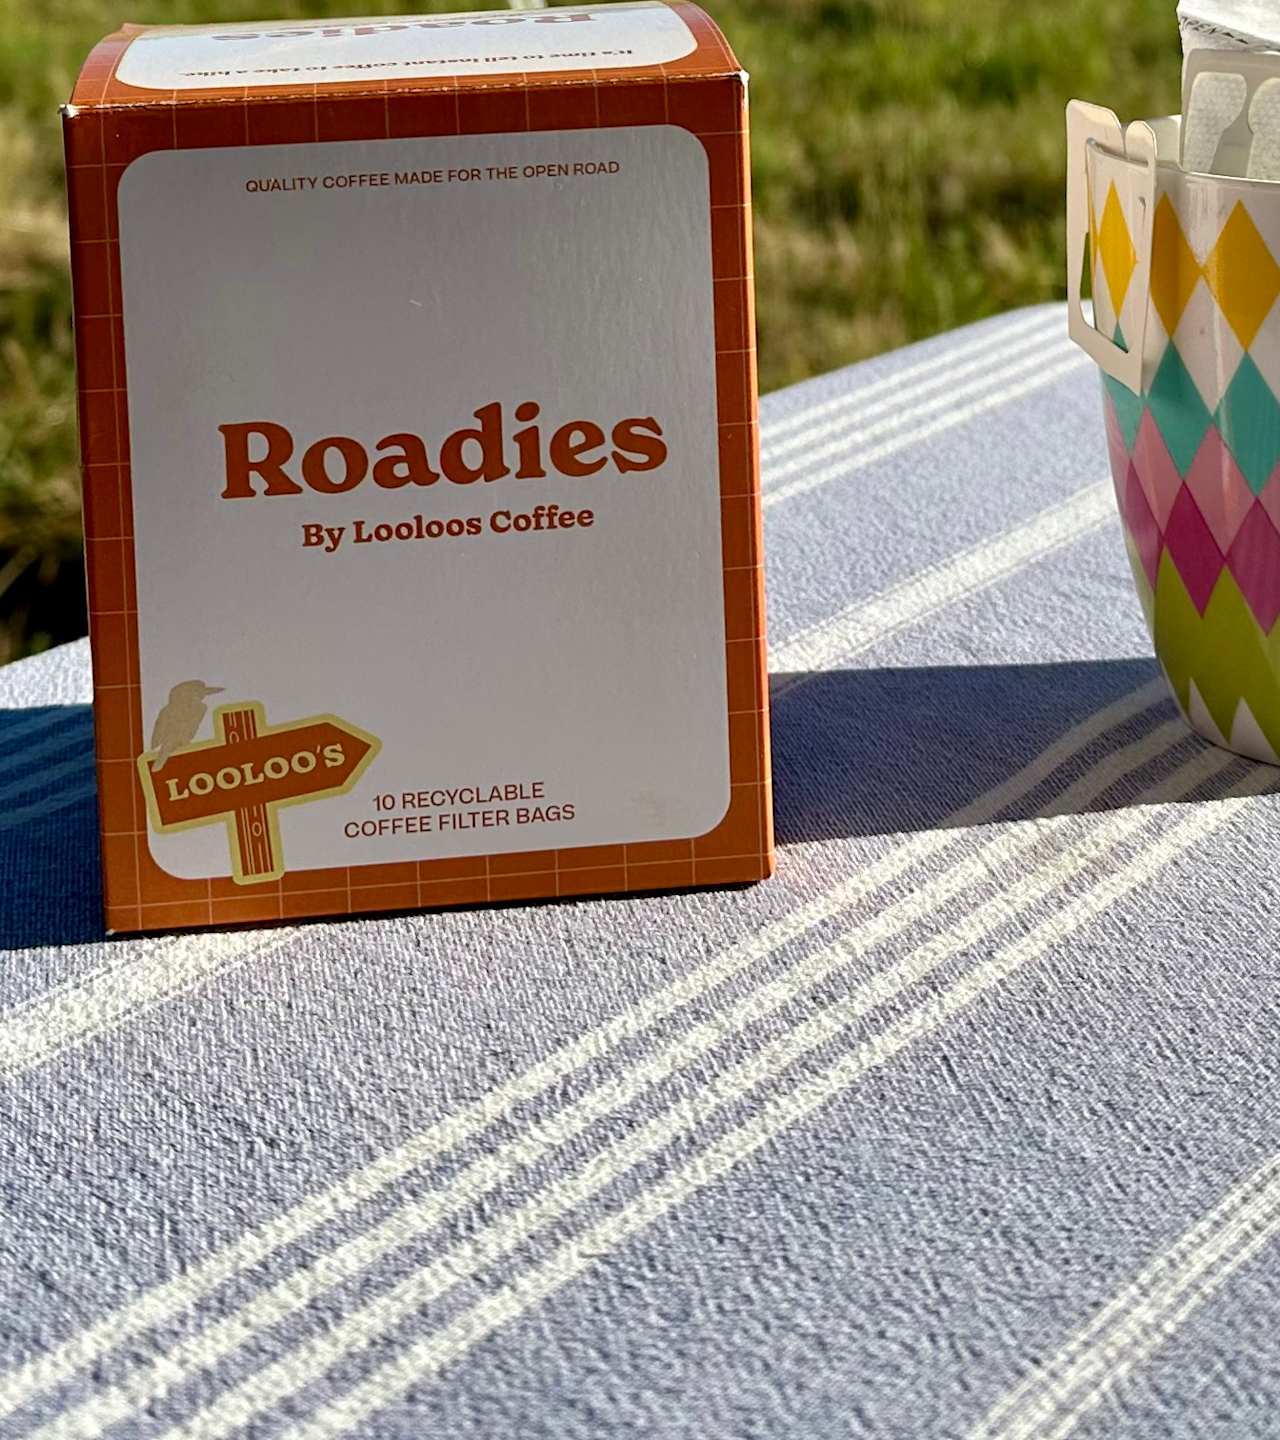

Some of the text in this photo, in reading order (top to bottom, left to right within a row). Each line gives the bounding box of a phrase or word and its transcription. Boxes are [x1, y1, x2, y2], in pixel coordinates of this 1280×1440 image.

[246, 161, 619, 192] QUALITY COFFEE MADE FOR THE OPEN ROAD
[218, 402, 667, 499] Roadies
[302, 505, 593, 552] By Looloos Coffee
[166, 743, 346, 801] LOOLOO'S
[374, 781, 546, 811] 10 RECYCLABLE
[345, 802, 575, 838] COFFEE FILTER BAGS
